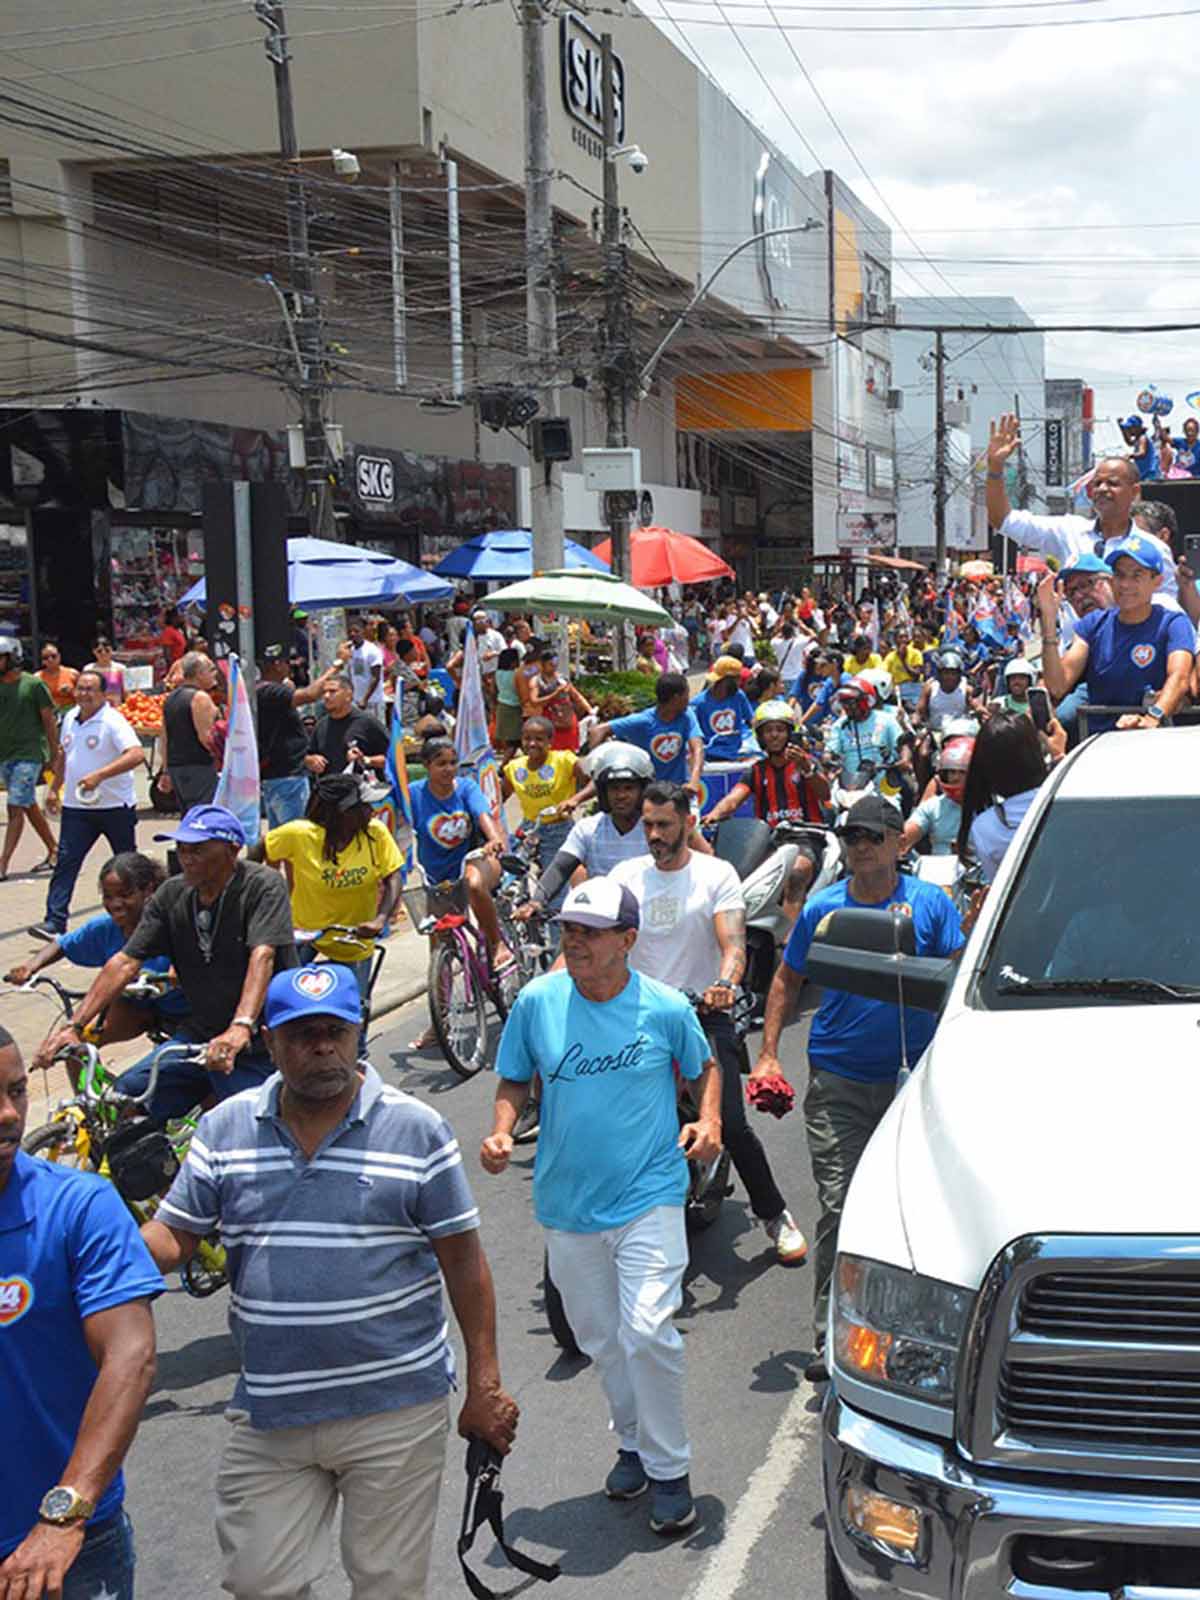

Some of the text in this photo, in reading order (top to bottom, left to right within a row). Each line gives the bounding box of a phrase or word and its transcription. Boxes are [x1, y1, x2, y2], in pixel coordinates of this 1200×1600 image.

[359, 460, 392, 497] SKG
[437, 814, 467, 840] 44
[548, 1037, 650, 1085] Lacoste
